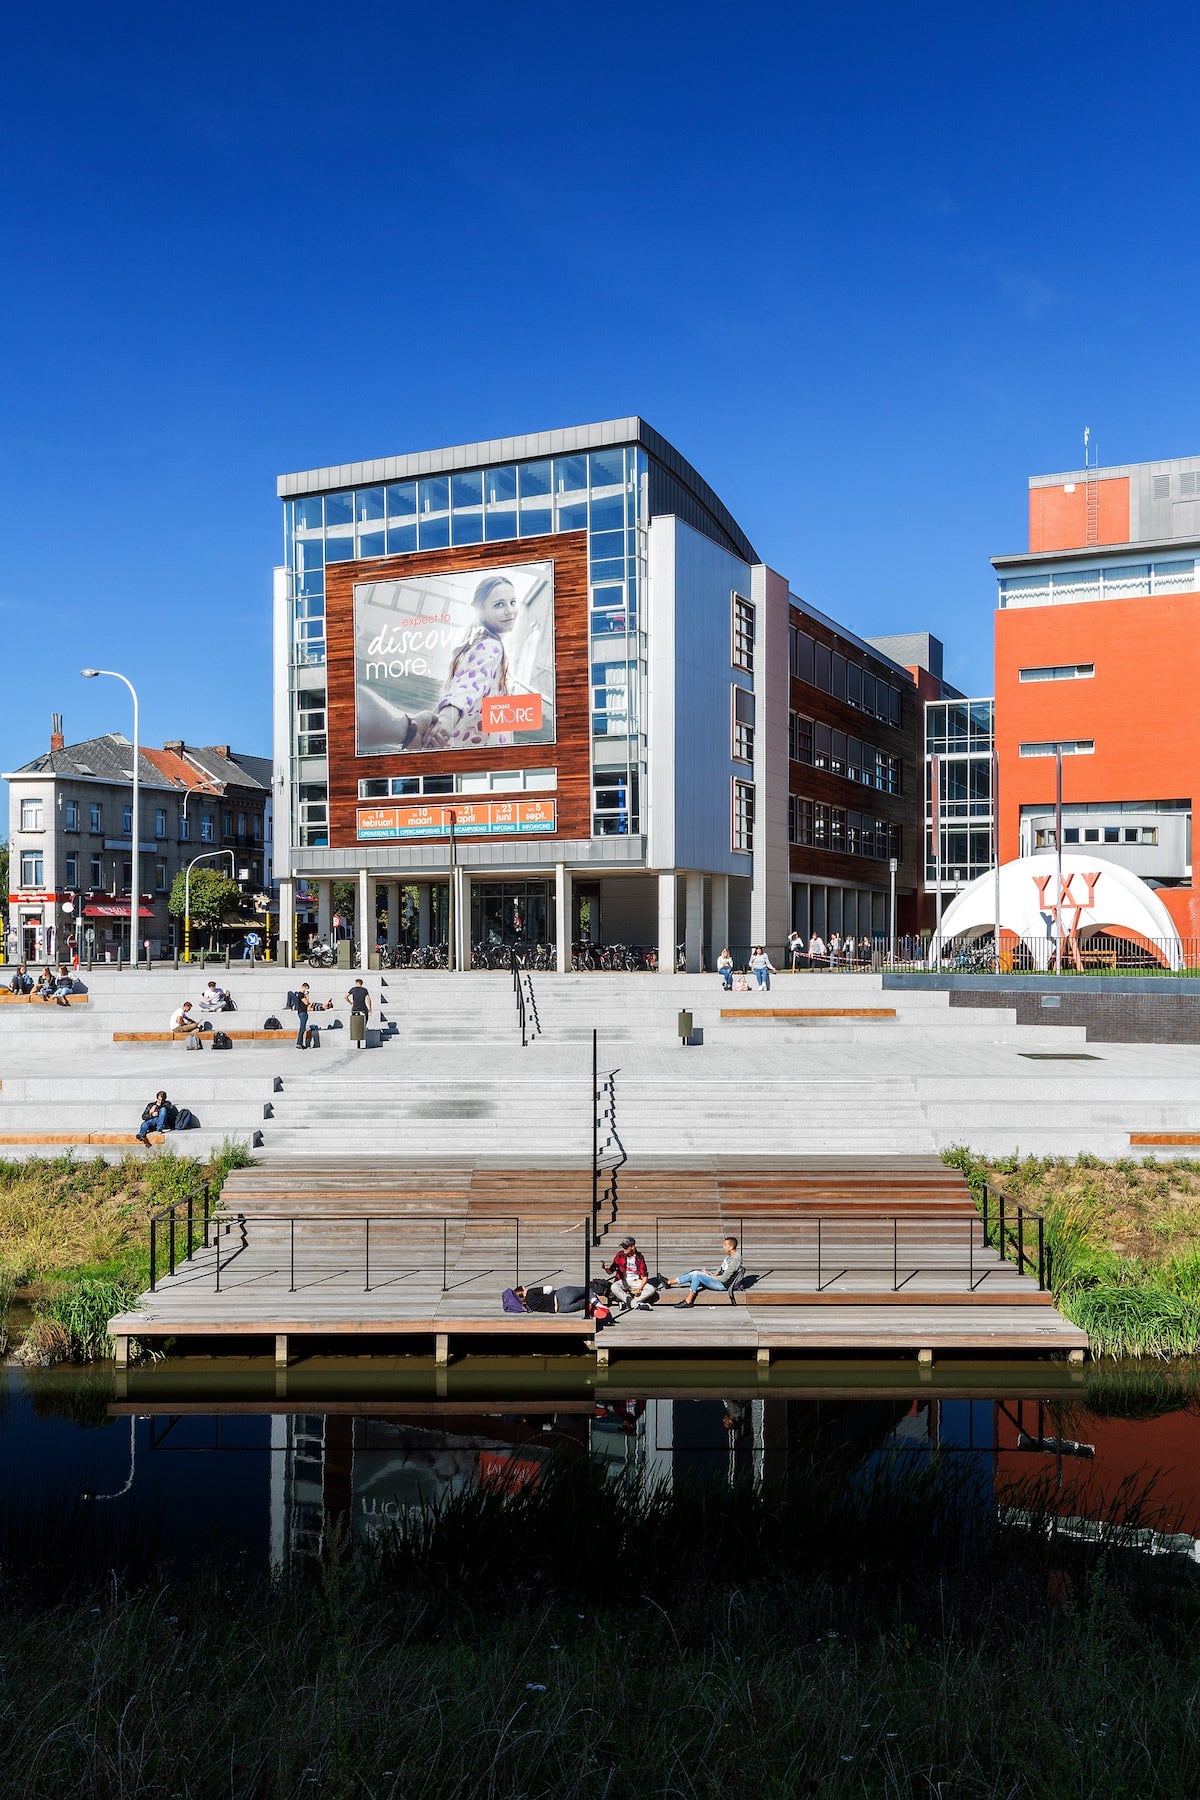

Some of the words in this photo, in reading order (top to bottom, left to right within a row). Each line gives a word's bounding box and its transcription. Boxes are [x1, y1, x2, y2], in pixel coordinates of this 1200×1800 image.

[402, 614, 438, 627] expect
[440, 612, 451, 623] to
[367, 623, 485, 656] discover
[366, 657, 431, 680] more.
[490, 707, 534, 725] MORE
[464, 806, 473, 814] 21
[502, 804, 512, 813] 23
[536, 803, 541, 811] 5
[375, 811, 384, 819] 14
[407, 816, 432, 825] maart
[456, 813, 476, 824] april
[496, 812, 512, 823] juni
[525, 811, 547, 822] sept.
[362, 818, 393, 828] februari
